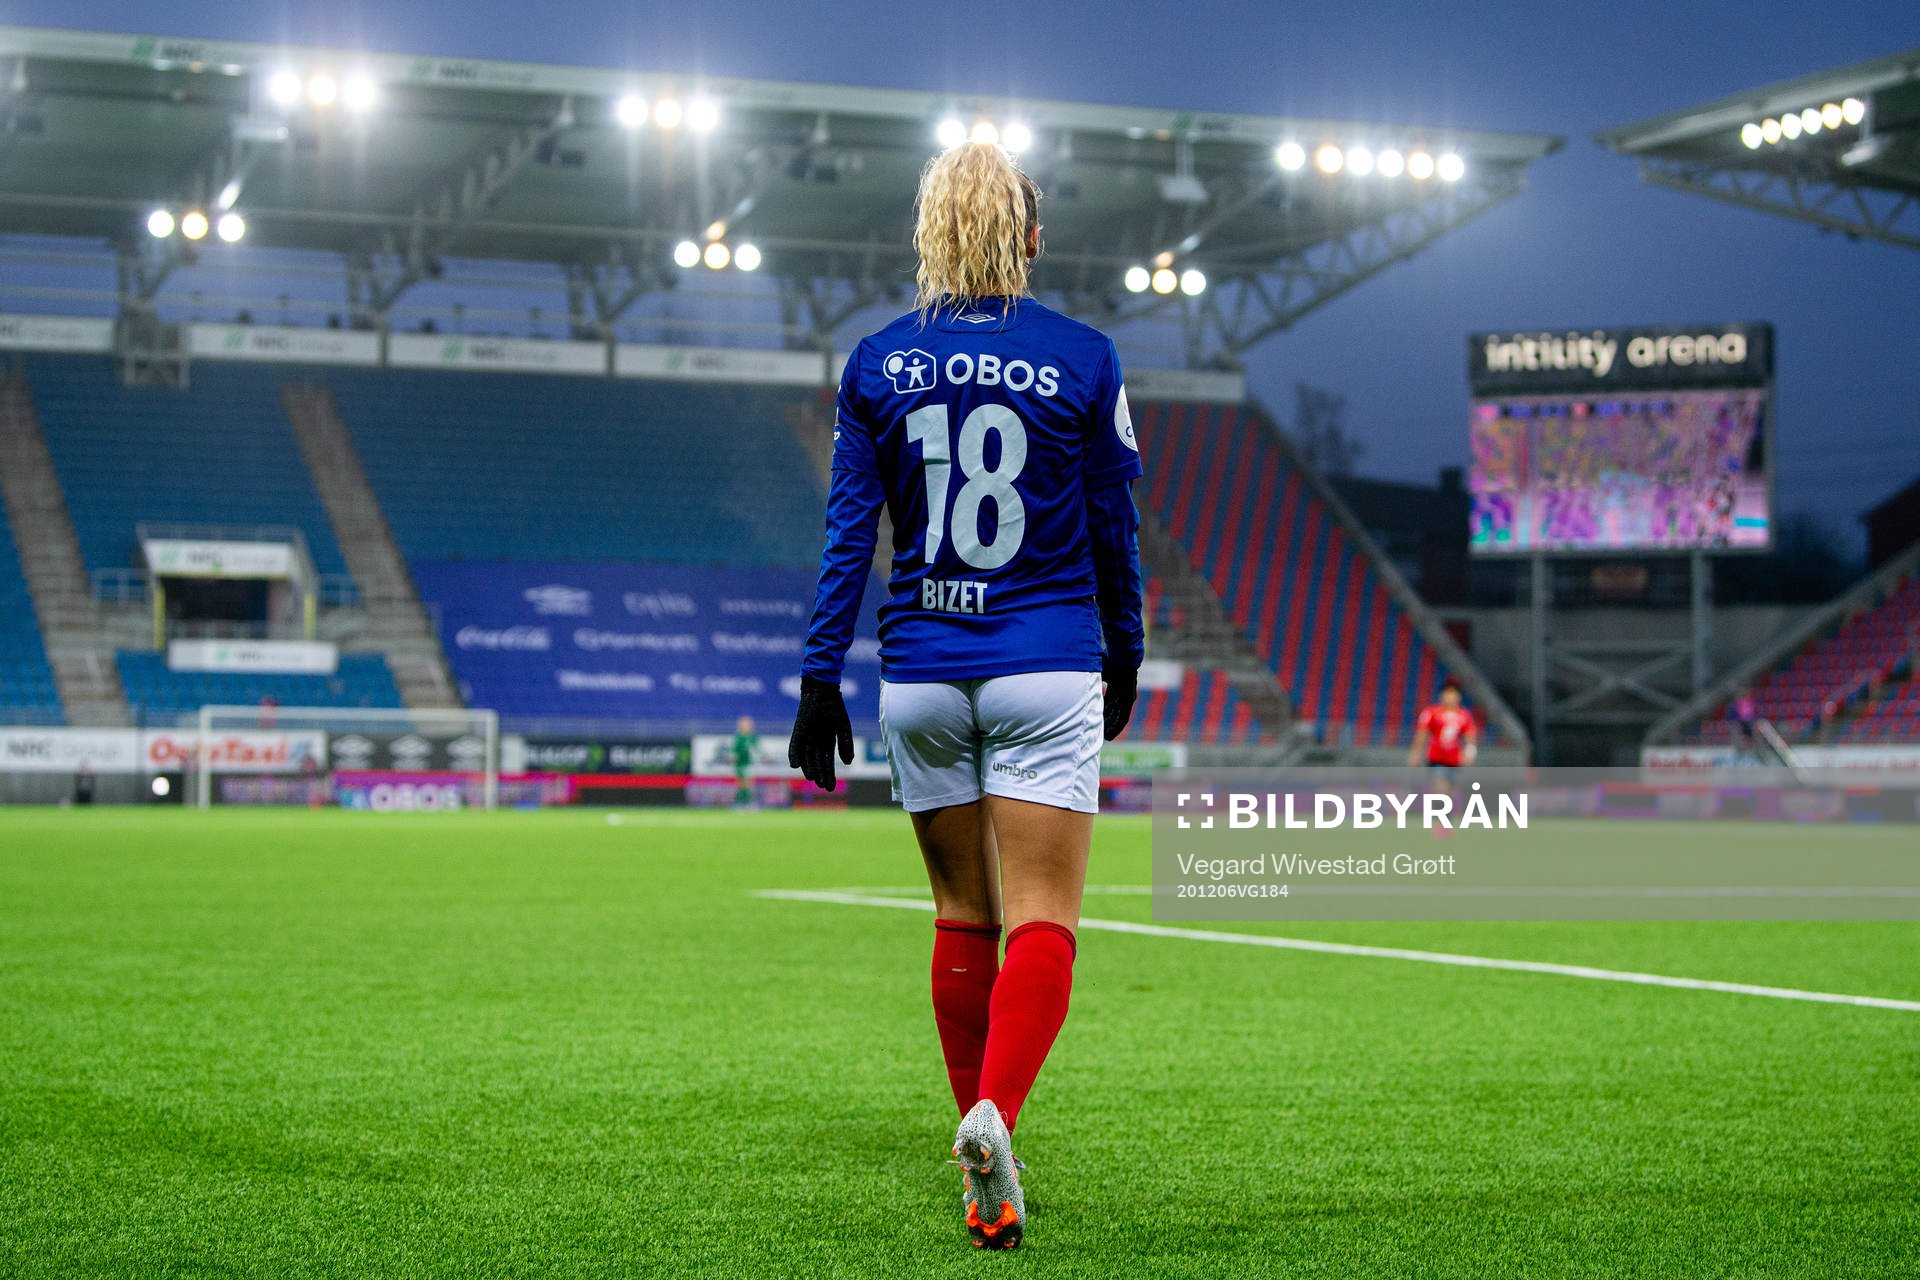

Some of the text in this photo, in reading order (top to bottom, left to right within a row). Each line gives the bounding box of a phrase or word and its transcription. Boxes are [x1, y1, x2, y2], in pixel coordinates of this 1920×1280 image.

[1627, 333, 1747, 368] arena
[945, 352, 1060, 397] OBOS
[905, 403, 1028, 570] 18
[922, 577, 988, 614] BIZET
[992, 760, 1038, 780] umbro
